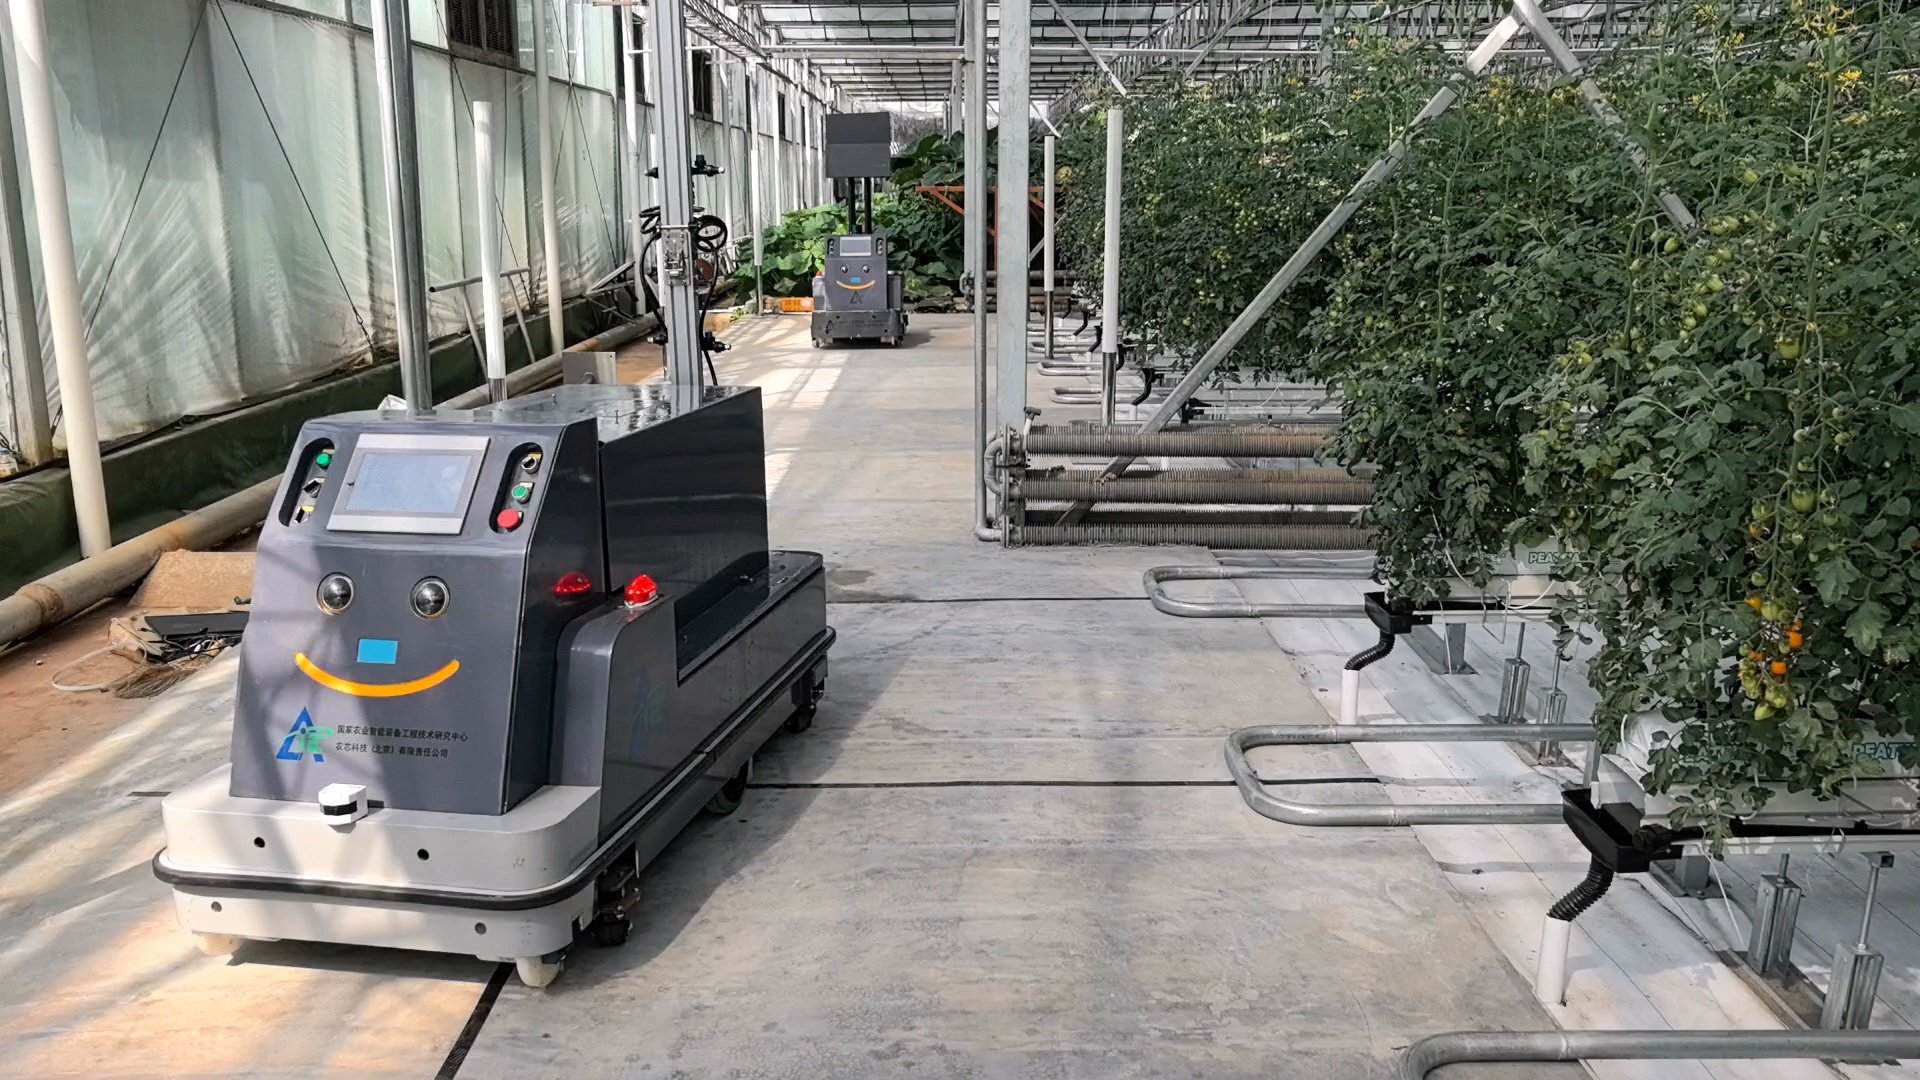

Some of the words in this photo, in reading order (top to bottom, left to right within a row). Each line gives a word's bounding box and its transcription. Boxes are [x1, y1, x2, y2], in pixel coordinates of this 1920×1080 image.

[337, 724, 469, 742] 国家农业智能装备工程技术研究中心
